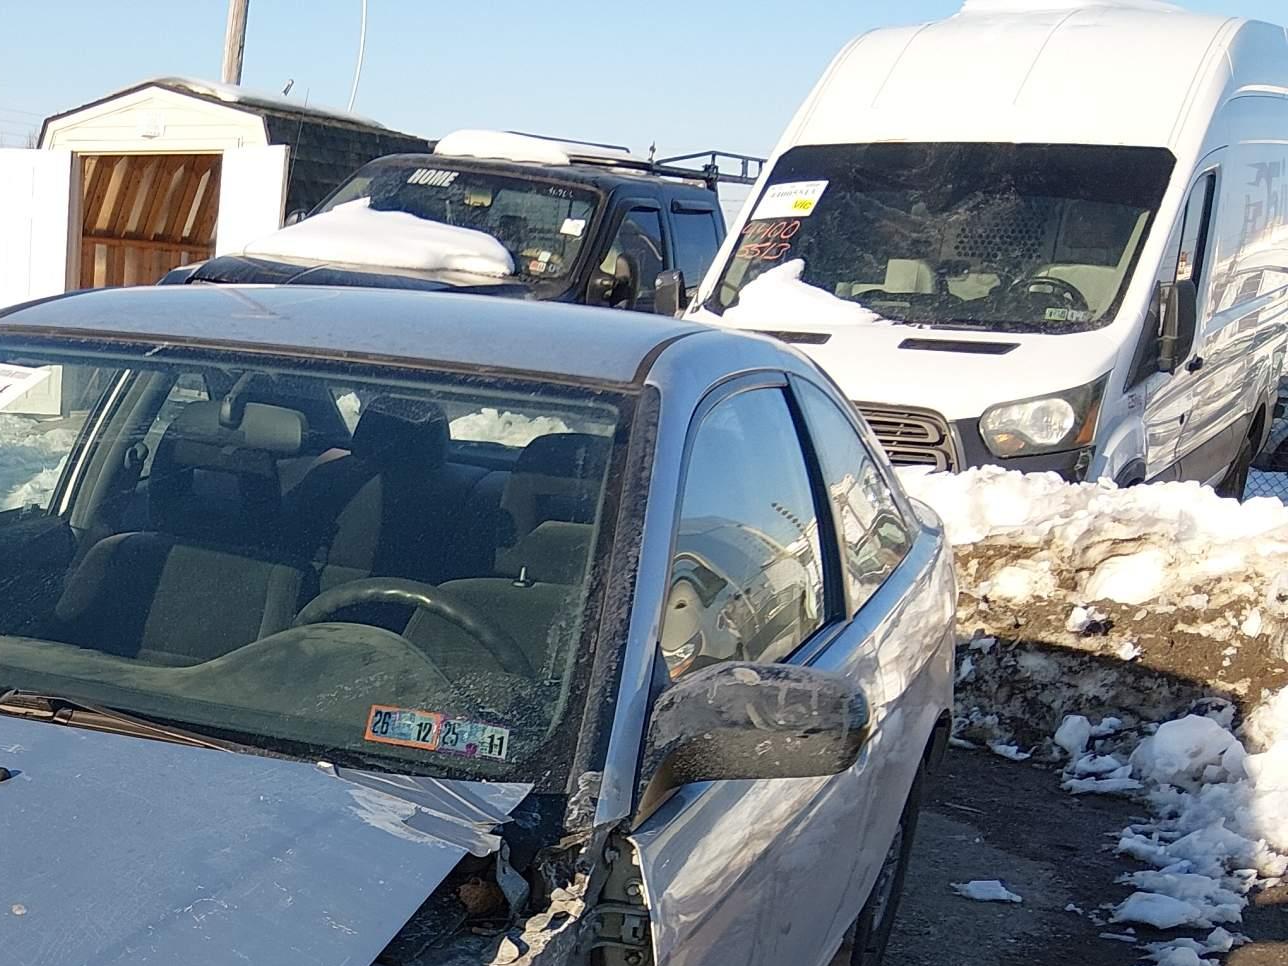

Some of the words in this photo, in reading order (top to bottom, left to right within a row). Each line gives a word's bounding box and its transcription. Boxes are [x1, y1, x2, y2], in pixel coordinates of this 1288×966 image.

[406, 168, 460, 187] HOME
[371, 711, 392, 735] 26
[416, 722, 433, 743] 12
[442, 721, 461, 747] 25
[487, 734, 505, 756] 11
